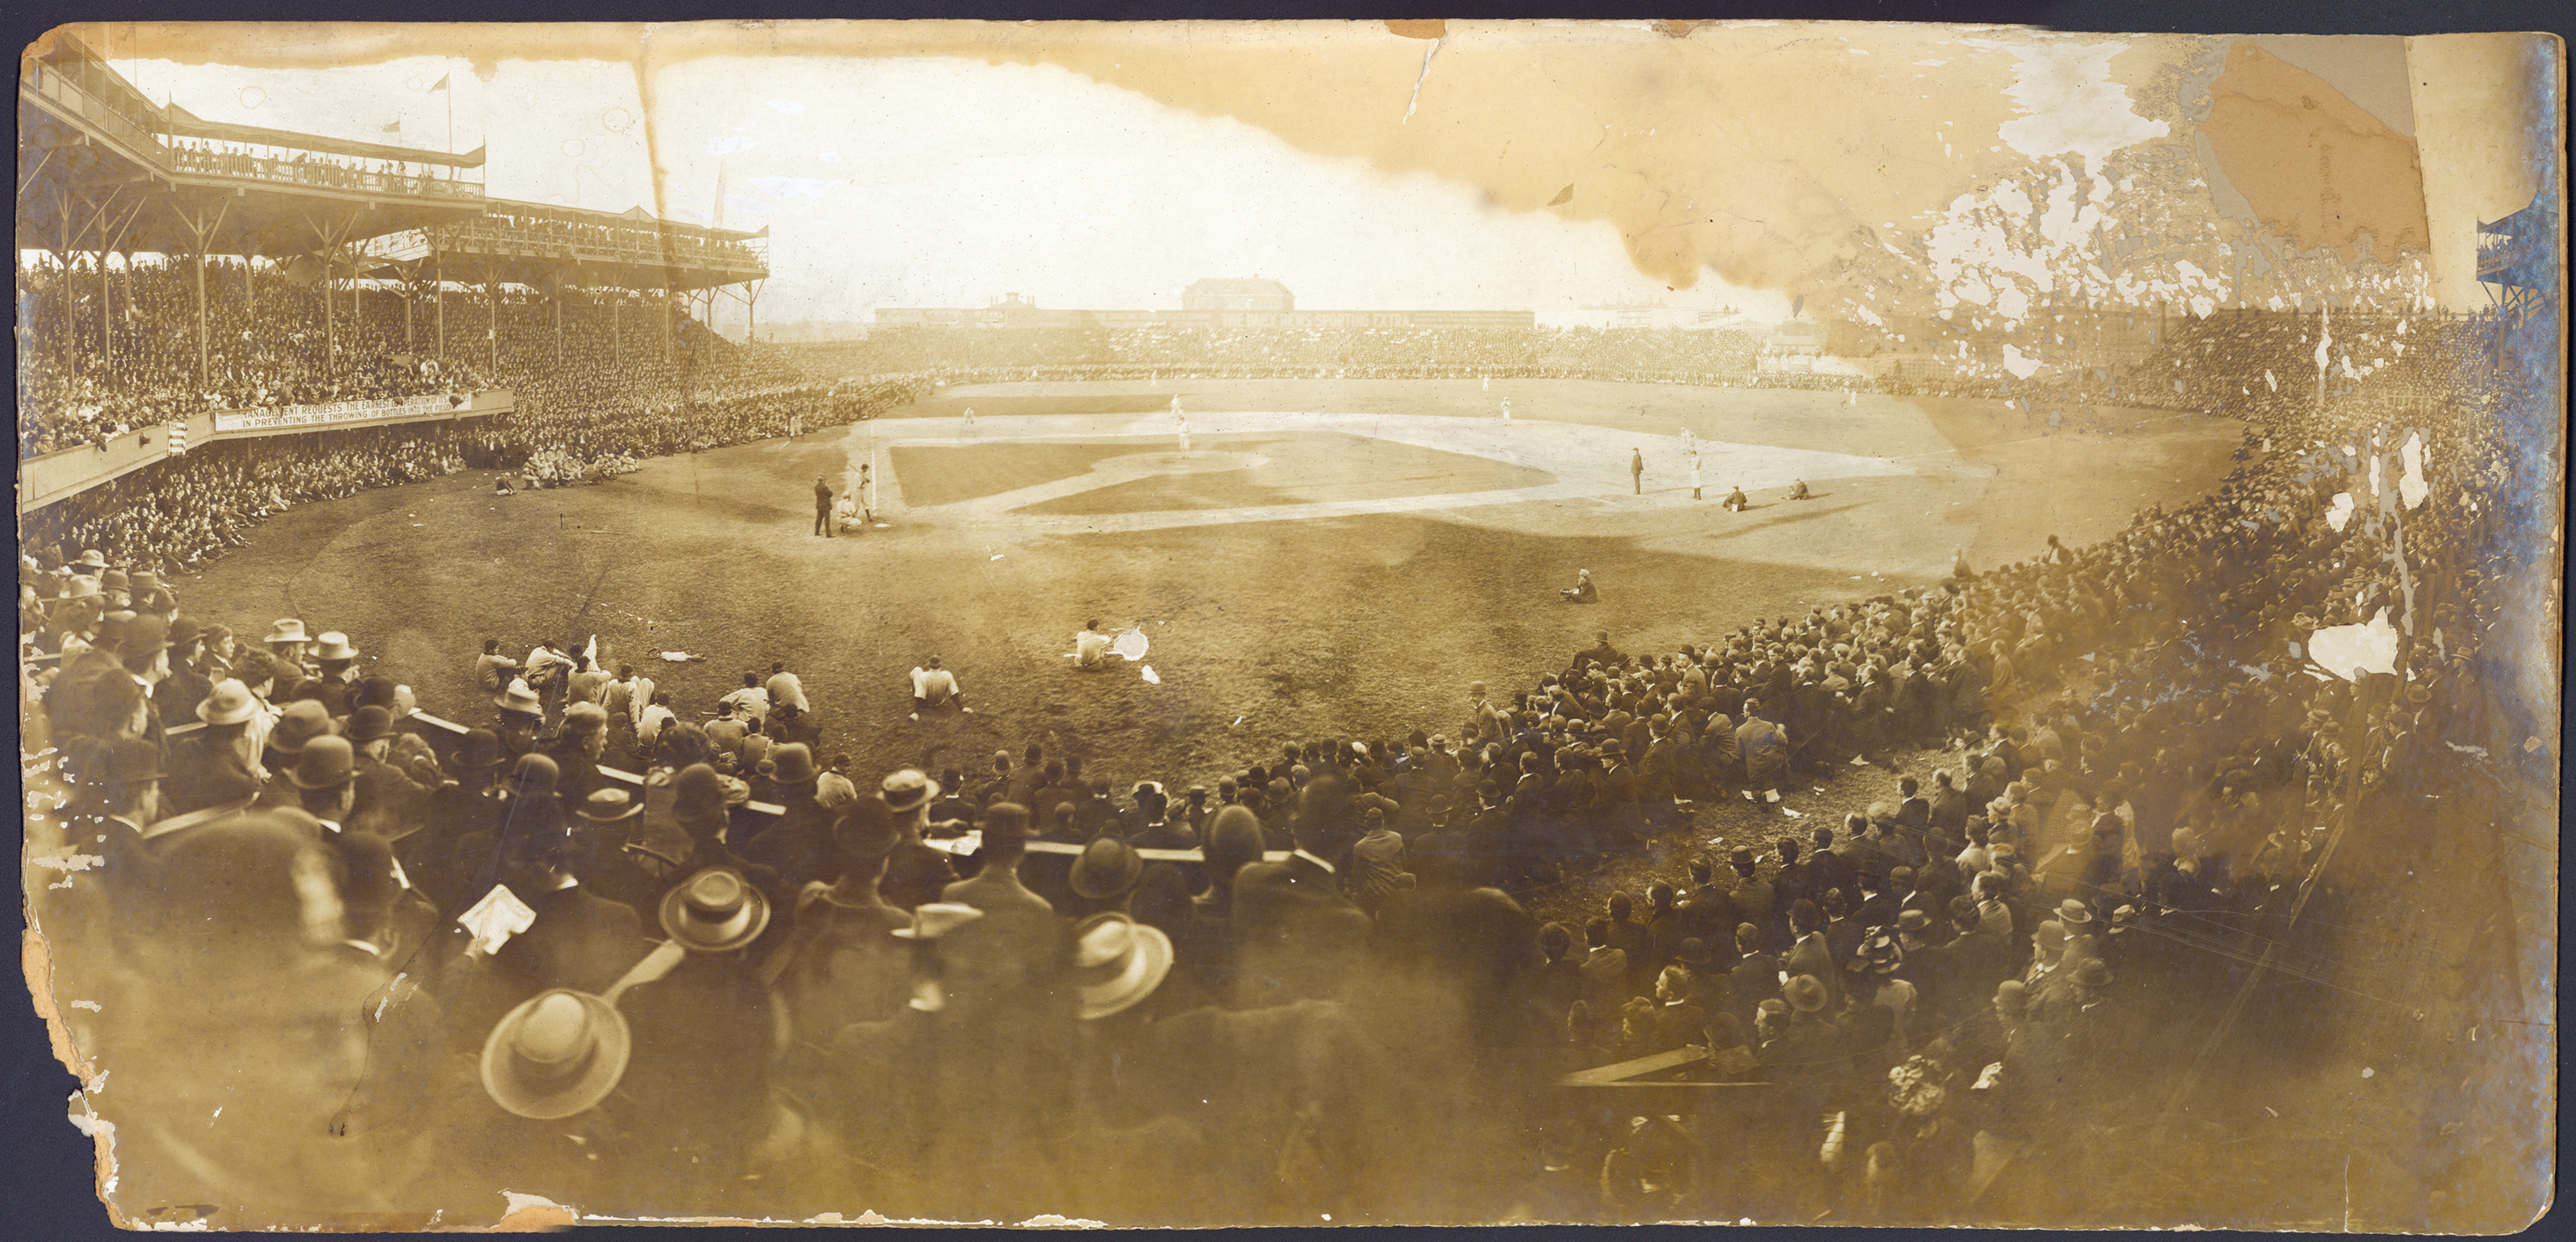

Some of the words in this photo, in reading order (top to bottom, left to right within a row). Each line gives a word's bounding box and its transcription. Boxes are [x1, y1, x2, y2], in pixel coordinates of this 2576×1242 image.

[1221, 312, 1244, 327] THE
[1280, 312, 1312, 327] NEWS
[1315, 312, 1370, 327] SPORTING
[1373, 312, 1409, 327] EXTRA
[242, 419, 251, 428] IN
[254, 415, 307, 427] PREVENTING
[311, 414, 325, 423] THE
[328, 410, 368, 421] THROWING
[382, 407, 406, 416] BOTTLES
[243, 406, 298, 419] ANAGEENT
[302, 403, 342, 415] REQUESTS
[347, 401, 359, 411] THE
[362, 399, 390, 410] EARNEST
[431, 396, 438, 405] OF
[438, 395, 447, 404] ITS
